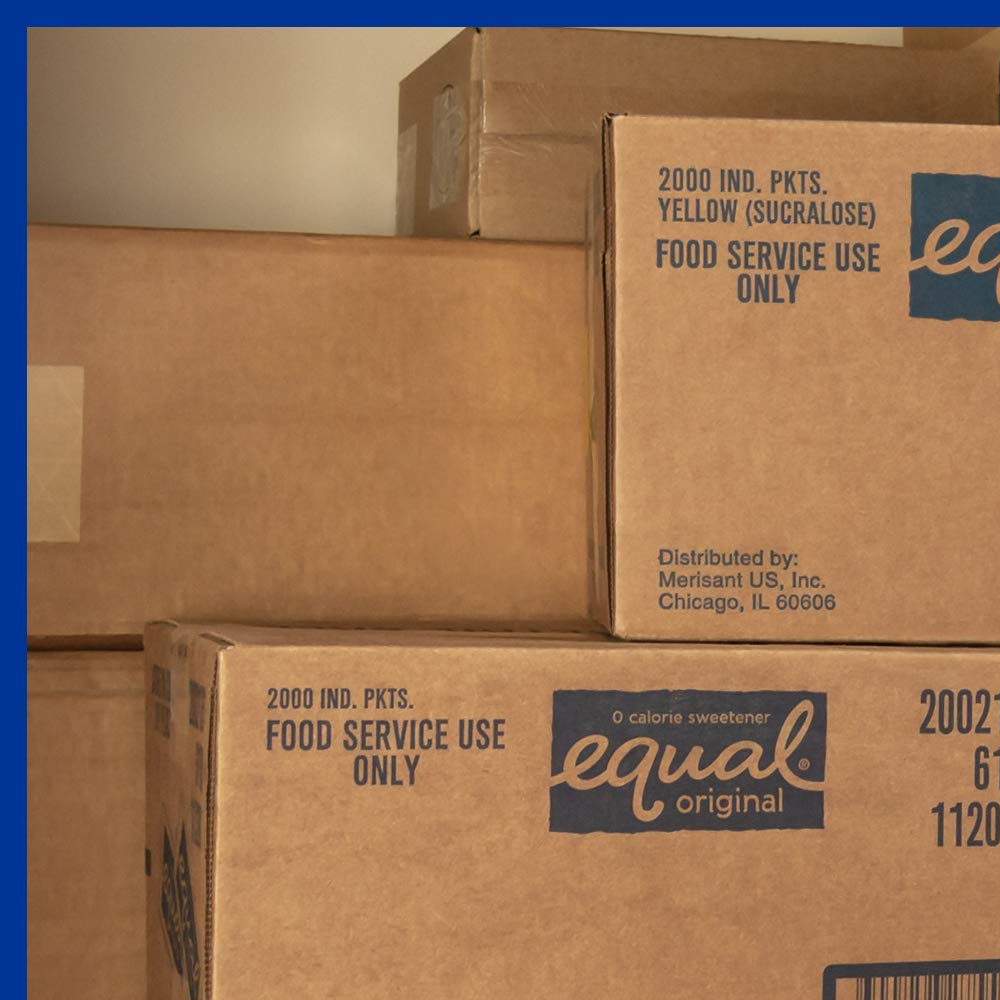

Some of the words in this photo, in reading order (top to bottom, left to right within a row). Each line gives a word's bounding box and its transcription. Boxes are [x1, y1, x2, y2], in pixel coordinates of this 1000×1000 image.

[658, 167, 712, 193] 2000
[720, 169, 762, 194] IND.
[770, 170, 828, 195] PKTS.
[658, 198, 738, 224] YELLOW
[745, 200, 877, 229] (SUCRALOSE)
[656, 239, 718, 269] FOOD
[727, 241, 826, 271] SERVICE
[835, 243, 881, 272] USE
[737, 274, 800, 304] ONLY
[658, 549, 764, 566] Distributed
[770, 550, 799, 570] by:
[658, 571, 743, 589] Merisant
[750, 571, 785, 591] US,
[792, 572, 826, 589] Inc.
[658, 592, 744, 614] Chicago,
[751, 593, 770, 610] IL
[775, 594, 836, 611] 60606
[267, 687, 314, 710] 2000
[320, 687, 357, 709] IND.
[363, 687, 414, 709] PKTS.
[629, 710, 683, 724] calorie
[688, 712, 771, 724] sweetener
[266, 719, 332, 751] FOOD
[343, 719, 449, 751] SERVICE
[458, 718, 506, 750] USE
[353, 754, 421, 786] ONLY
[676, 787, 784, 819] original
